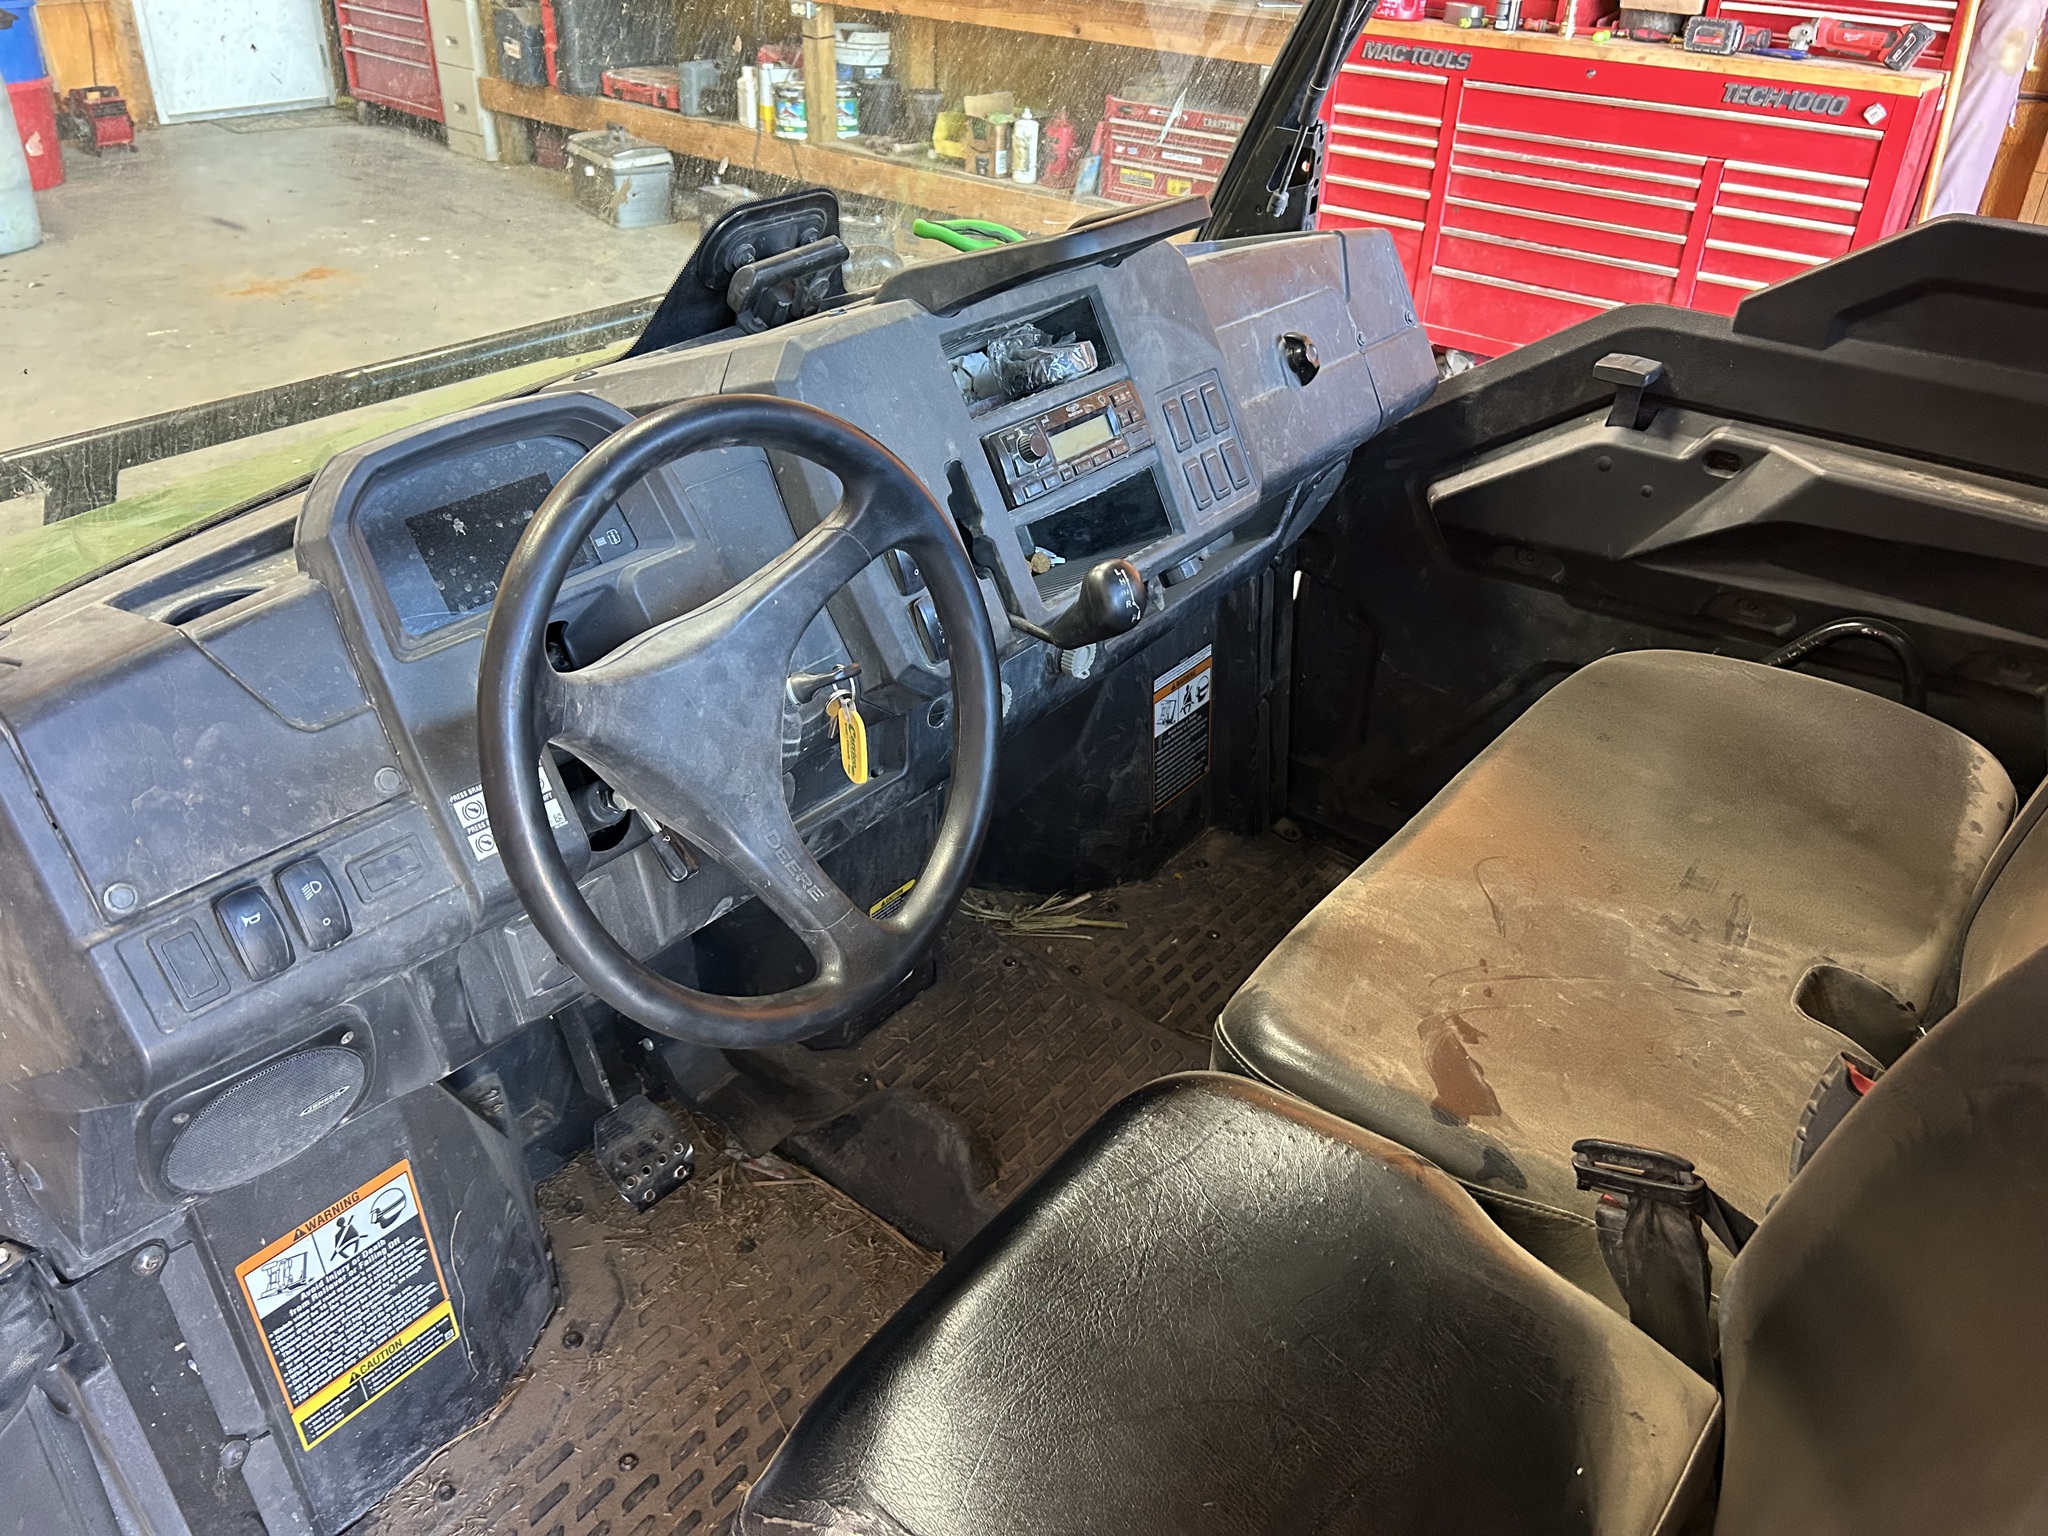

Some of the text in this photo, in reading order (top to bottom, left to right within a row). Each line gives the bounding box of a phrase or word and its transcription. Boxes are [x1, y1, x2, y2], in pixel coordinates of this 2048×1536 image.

[1361, 41, 1472, 70] MAC TOOLS
[1722, 82, 1786, 108] TECH
[1787, 90, 1850, 116] 1000
[450, 784, 482, 803] PRESS BRA
[467, 822, 485, 834] PRESS
[763, 828, 825, 902] DEERE
[304, 1190, 360, 1232] WARNING
[288, 1297, 310, 1316] from
[310, 1272, 347, 1301] Rollover
[347, 1265, 357, 1277] or
[358, 1245, 387, 1270] Falling
[387, 1236, 400, 1250] Off
[299, 1279, 324, 1300] Avoid
[325, 1261, 350, 1284] Injury
[351, 1254, 361, 1265] or
[361, 1237, 386, 1258] Death
[359, 1337, 402, 1375] CAUTION
